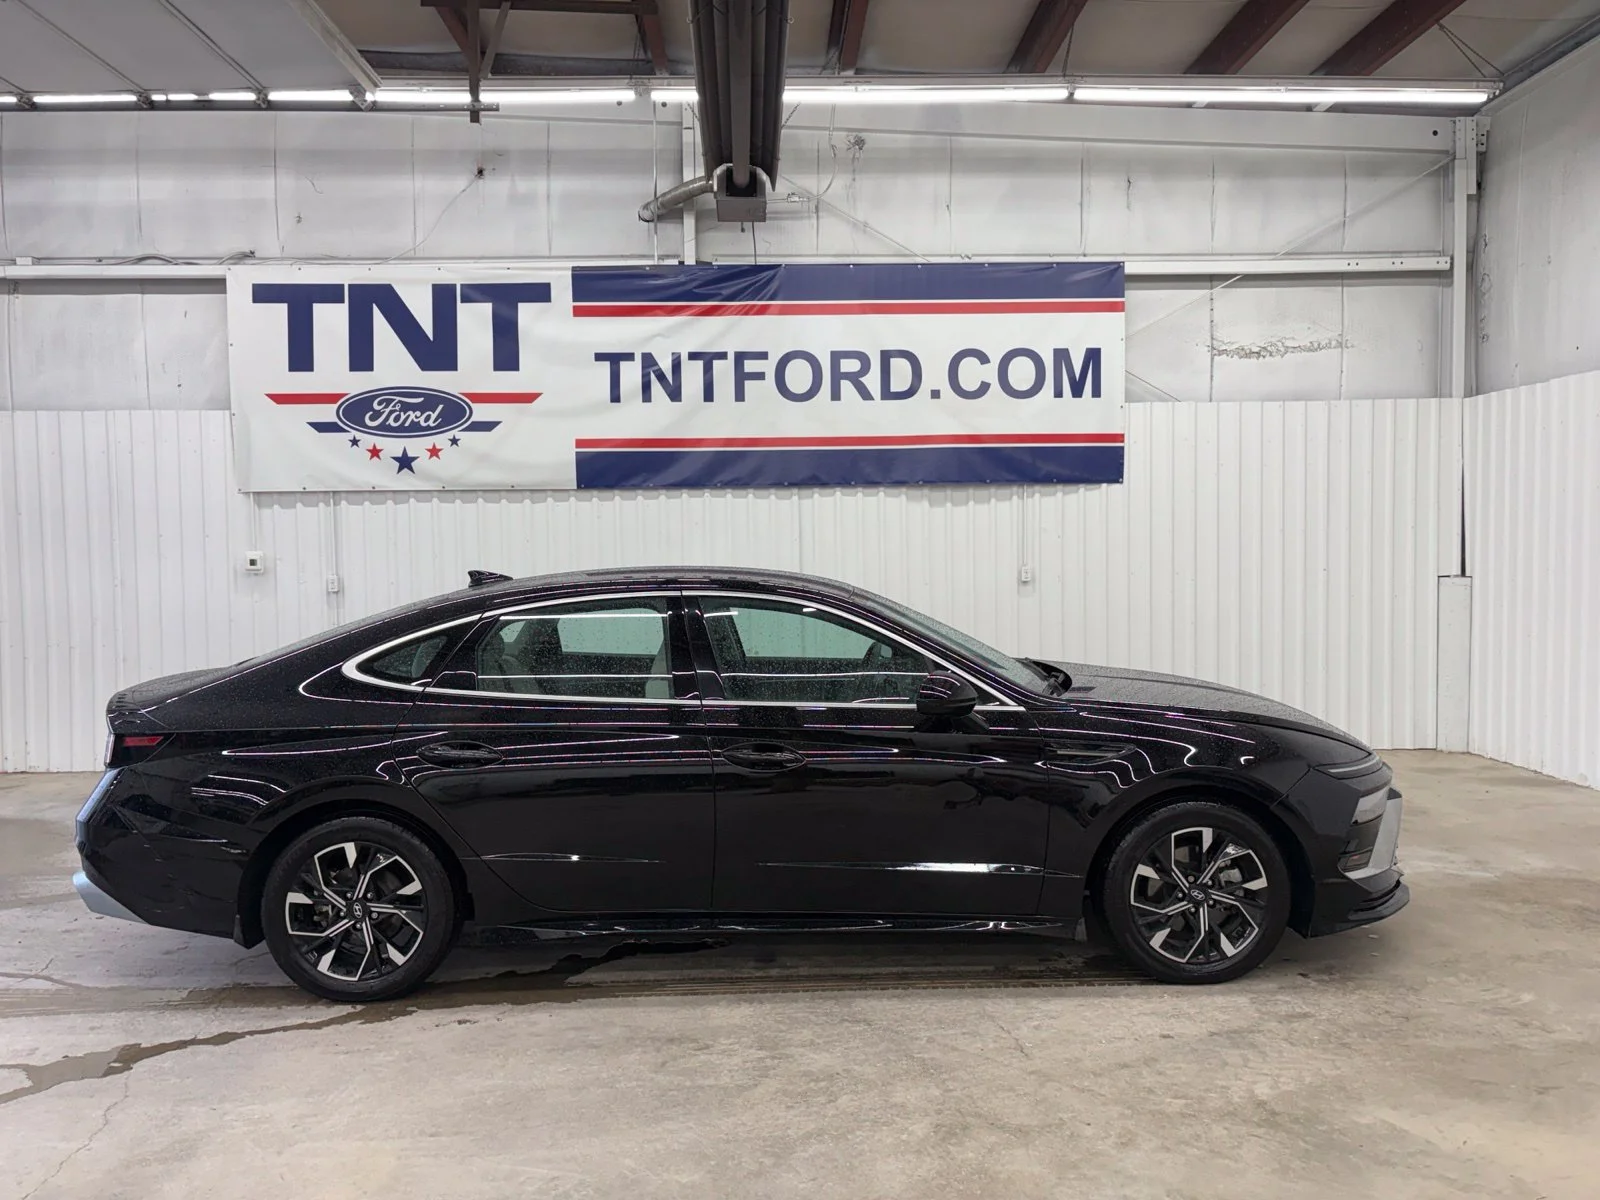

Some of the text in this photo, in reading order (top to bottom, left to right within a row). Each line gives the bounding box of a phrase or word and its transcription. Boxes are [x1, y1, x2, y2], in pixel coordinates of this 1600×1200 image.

[252, 282, 551, 372] TNT
[594, 347, 1102, 404] TNTFORD.COM
[364, 395, 444, 427] Ford
